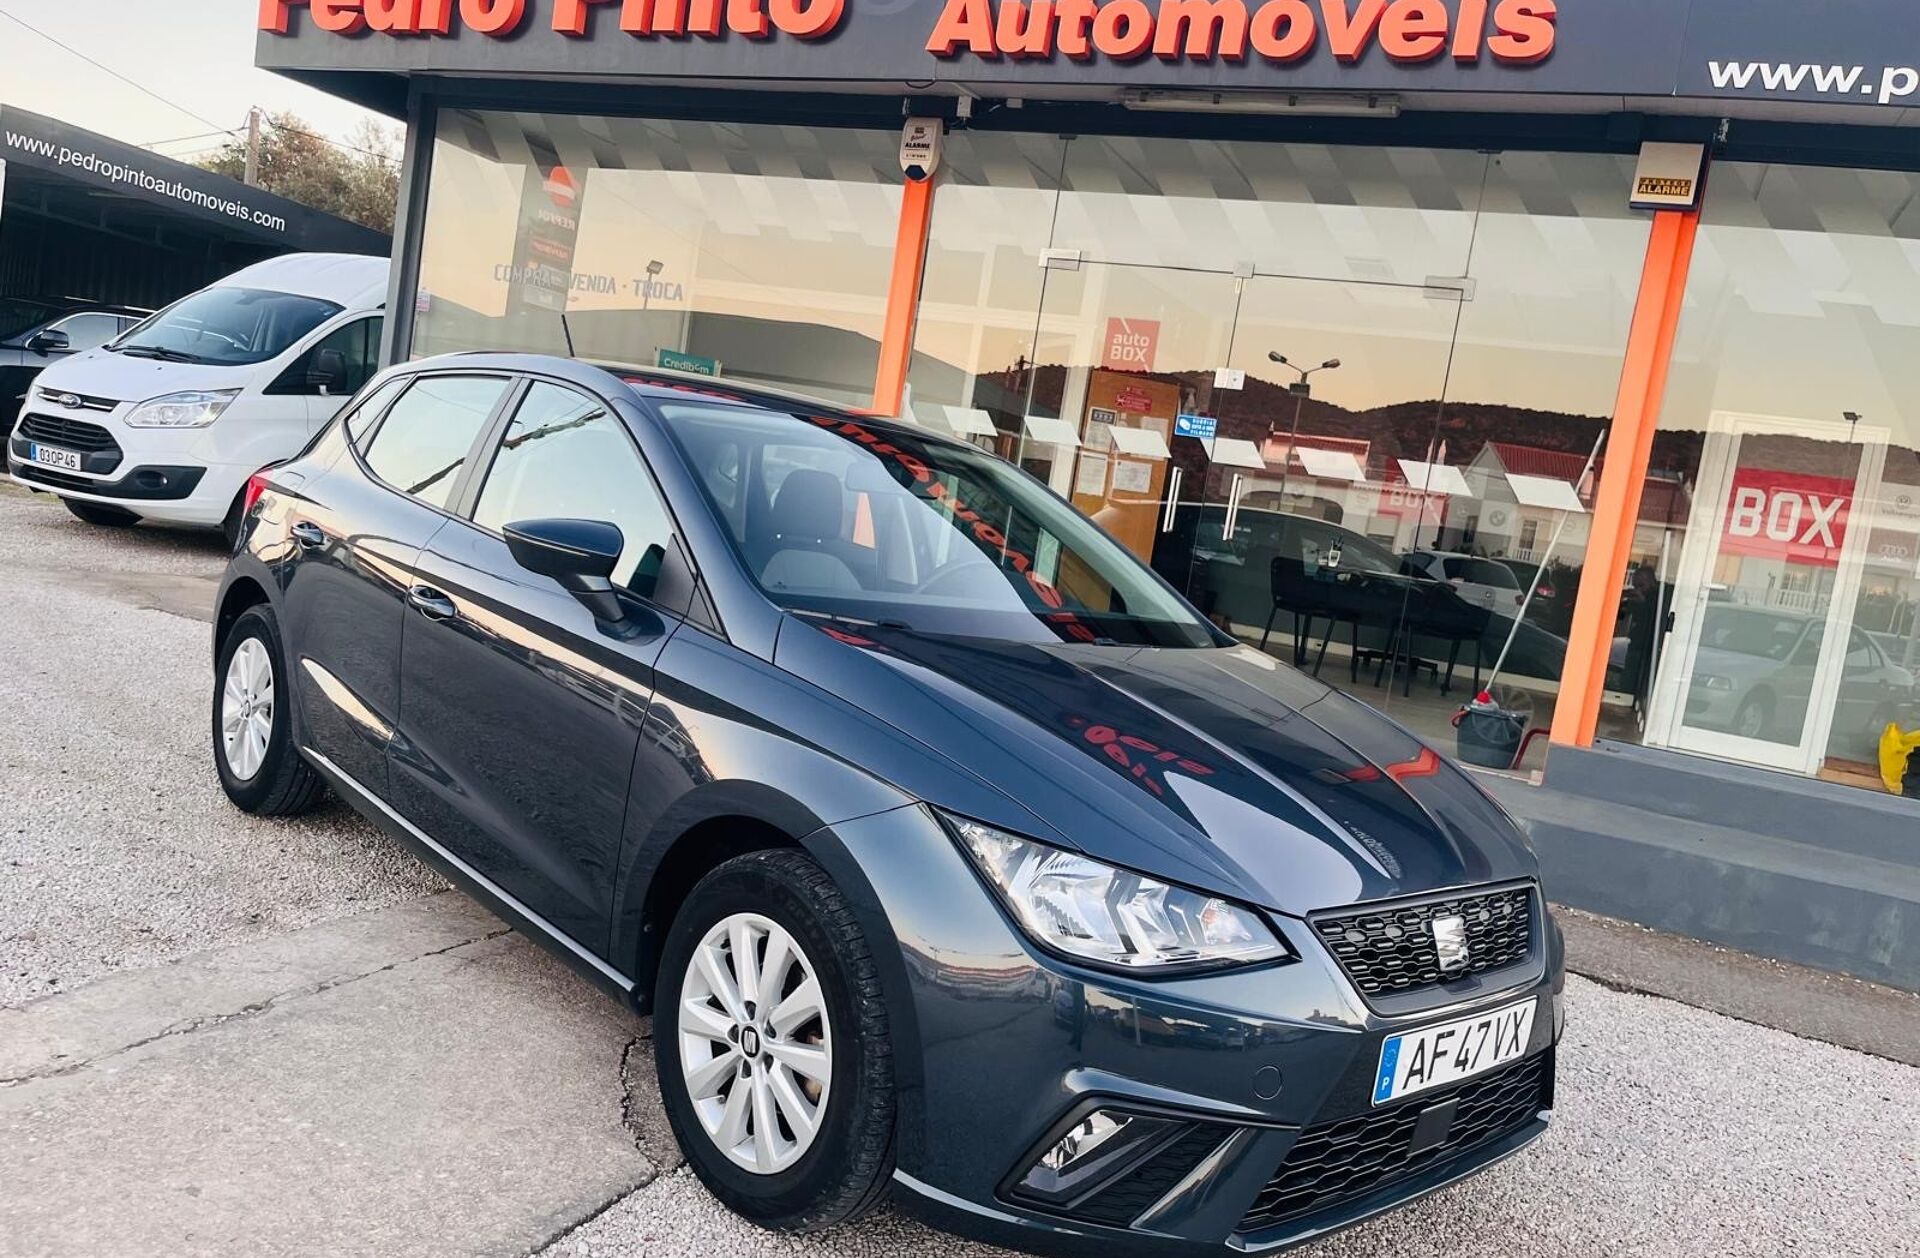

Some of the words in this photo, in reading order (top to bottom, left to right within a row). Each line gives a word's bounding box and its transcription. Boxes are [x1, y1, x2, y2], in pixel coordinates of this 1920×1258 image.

[5, 130, 286, 232] www.pedropintoautomoveis.com
[1639, 184, 1689, 196] ALARME
[569, 273, 616, 295] VENDA
[632, 279, 684, 302] TROCA
[1113, 333, 1150, 347] auto
[1110, 346, 1149, 362] BOX
[1729, 486, 1844, 548] BOX
[1381, 1076, 1390, 1091] P
